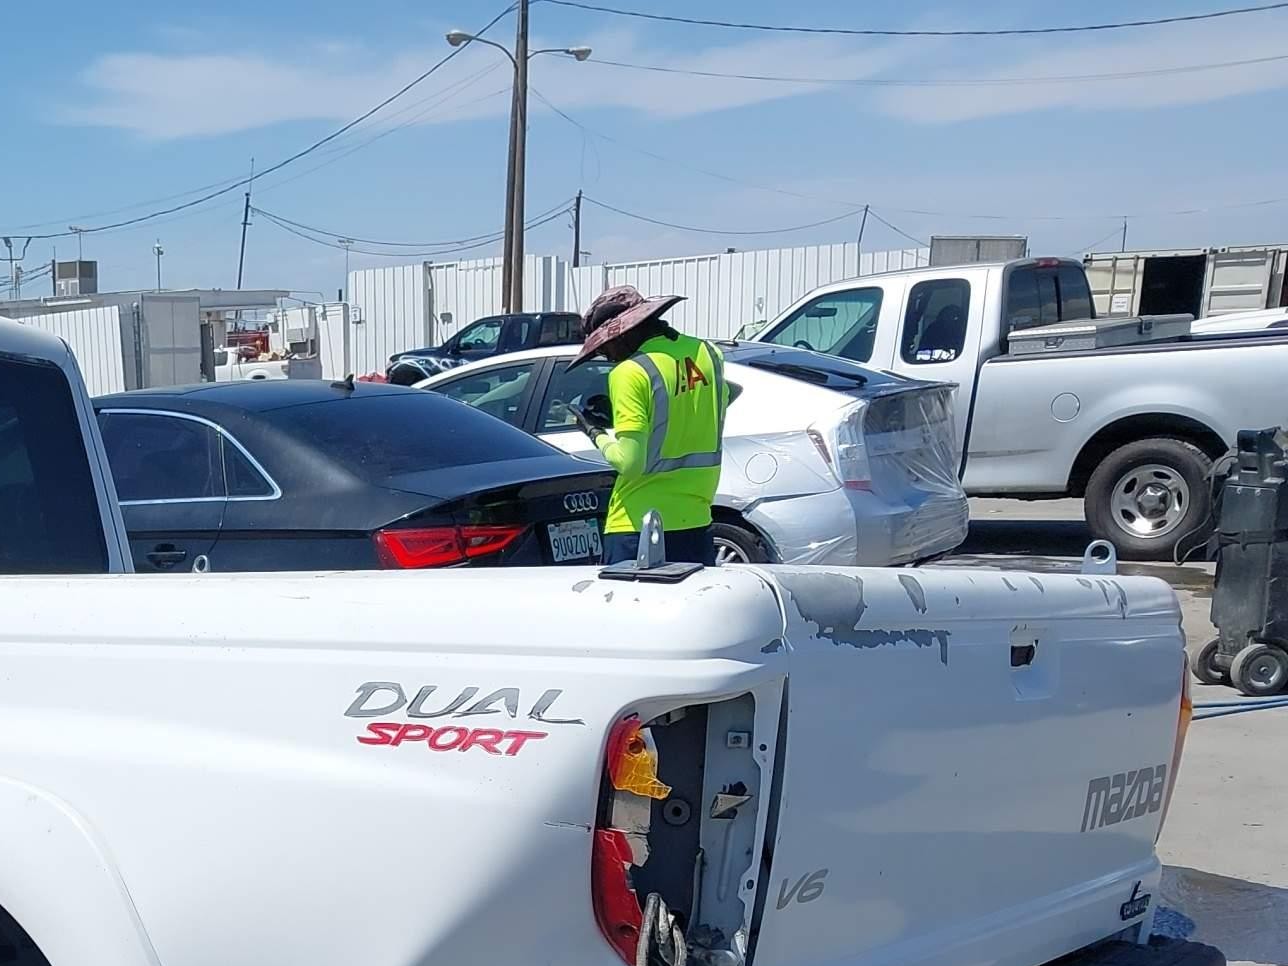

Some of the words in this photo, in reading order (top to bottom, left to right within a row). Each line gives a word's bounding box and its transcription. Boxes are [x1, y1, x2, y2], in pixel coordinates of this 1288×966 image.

[344, 681, 586, 726] DUAL
[357, 722, 549, 757] SPORT
[776, 868, 829, 911] V6
